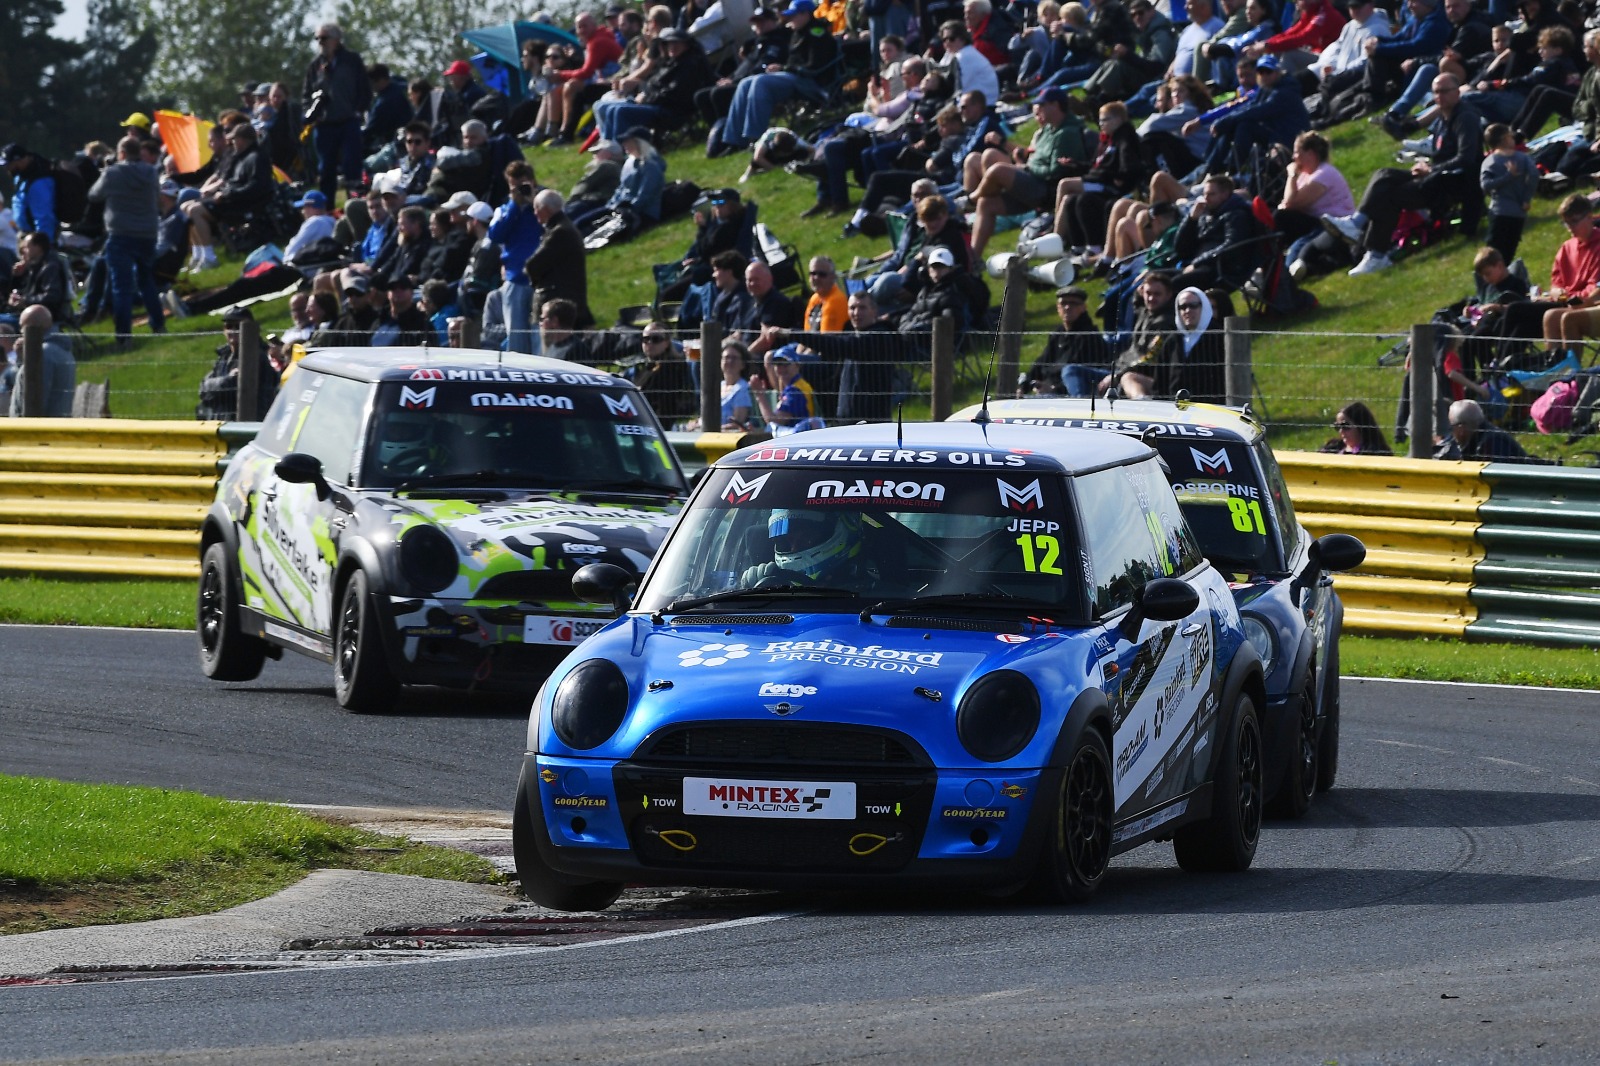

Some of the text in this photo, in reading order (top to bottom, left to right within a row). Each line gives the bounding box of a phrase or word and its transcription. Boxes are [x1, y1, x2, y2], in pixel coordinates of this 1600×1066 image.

[447, 369, 614, 386] MILLERS OILS
[1149, 424, 1214, 437] OILS
[790, 448, 1027, 467] MILLERS OILS
[1171, 482, 1260, 499] OSBORNE
[872, 498, 943, 508] MANAGEMENT
[1227, 496, 1267, 536] 81
[1007, 518, 1060, 534] JEPP
[1015, 533, 1063, 576] 12
[760, 639, 944, 668] Rainford
[767, 652, 922, 675] PRECISION
[652, 798, 677, 808] TOW
[709, 785, 800, 805] MINTEX
[737, 802, 801, 813] RACING
[864, 804, 891, 814] TOW
